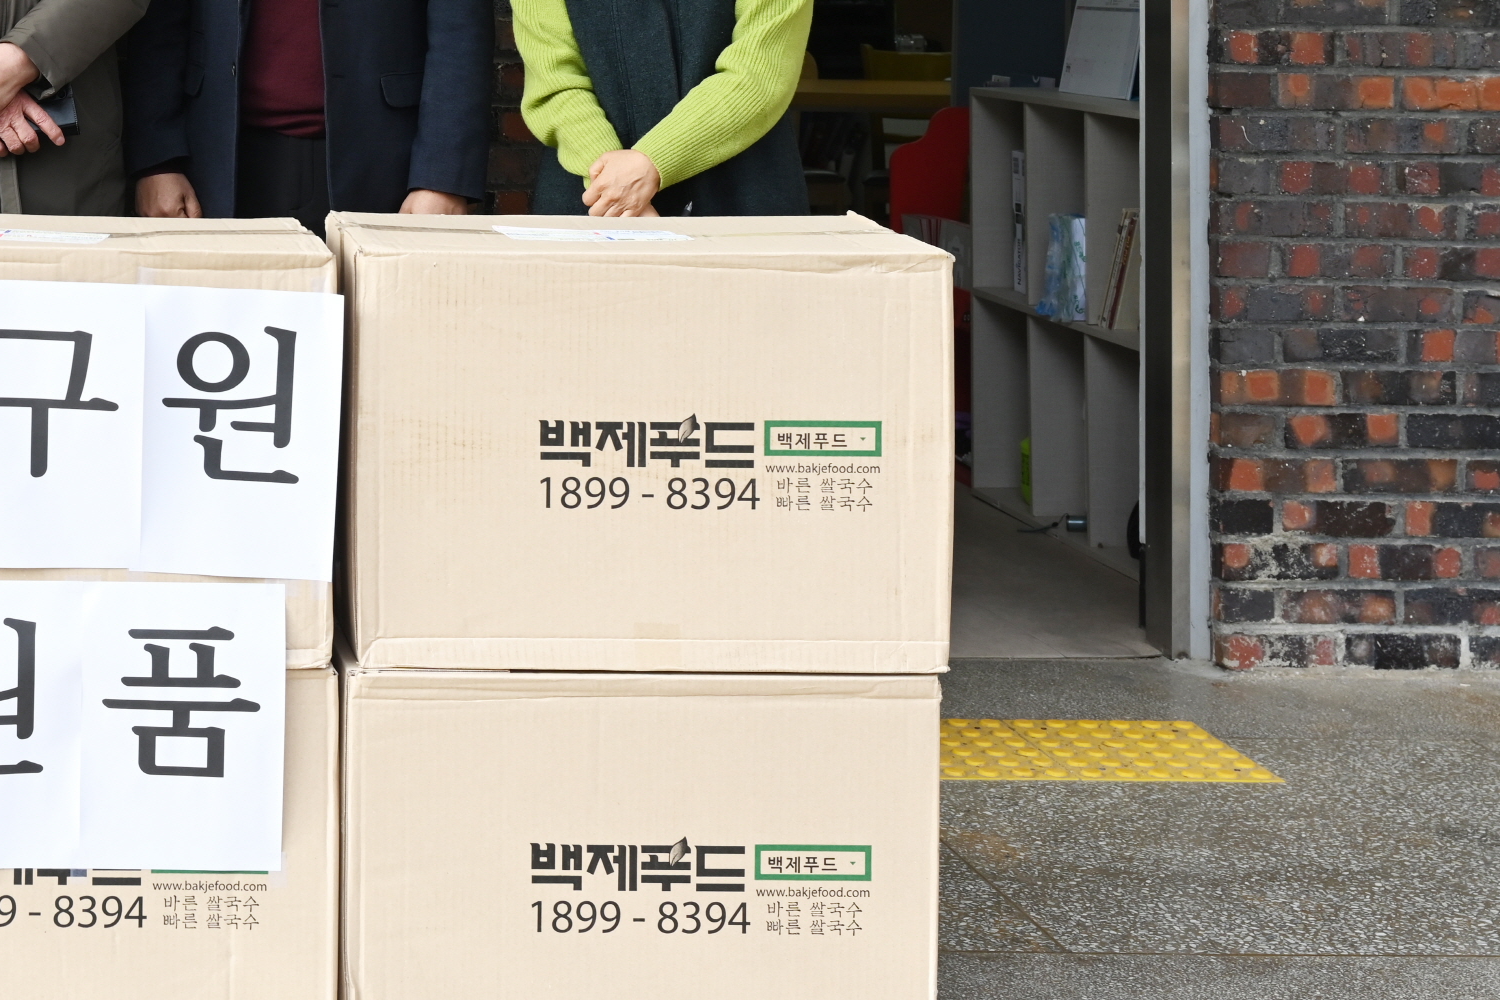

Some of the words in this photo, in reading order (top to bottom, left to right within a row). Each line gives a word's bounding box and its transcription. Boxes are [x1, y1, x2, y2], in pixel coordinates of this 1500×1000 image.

[539, 419, 755, 468] 백제푸드
[777, 432, 848, 450] 백제푸드
[765, 462, 881, 476] www.bakjefood.com
[540, 476, 630, 509] 1899
[667, 477, 760, 510] 8394
[776, 477, 811, 494] 바른
[819, 477, 873, 494] 쌀국수
[776, 495, 811, 511] 빠른
[819, 495, 873, 512] 쌀국수
[530, 842, 746, 892] 백제푸드
[768, 855, 838, 874] 백제푸드
[152, 880, 268, 894] www.bakjefood.com
[756, 886, 870, 900] www.bakjefood.com
[53, 895, 148, 929] 8394
[164, 895, 198, 911] 바른
[206, 895, 260, 912] 쌀국수
[766, 901, 801, 918] 바른
[809, 901, 863, 918] 쌀국수
[163, 912, 198, 929] 빠른
[206, 912, 260, 930] 쌀국수
[530, 900, 622, 933] 1899
[657, 902, 750, 934] 8394
[766, 919, 801, 935] 빠른
[809, 919, 863, 936] 쌀국수
